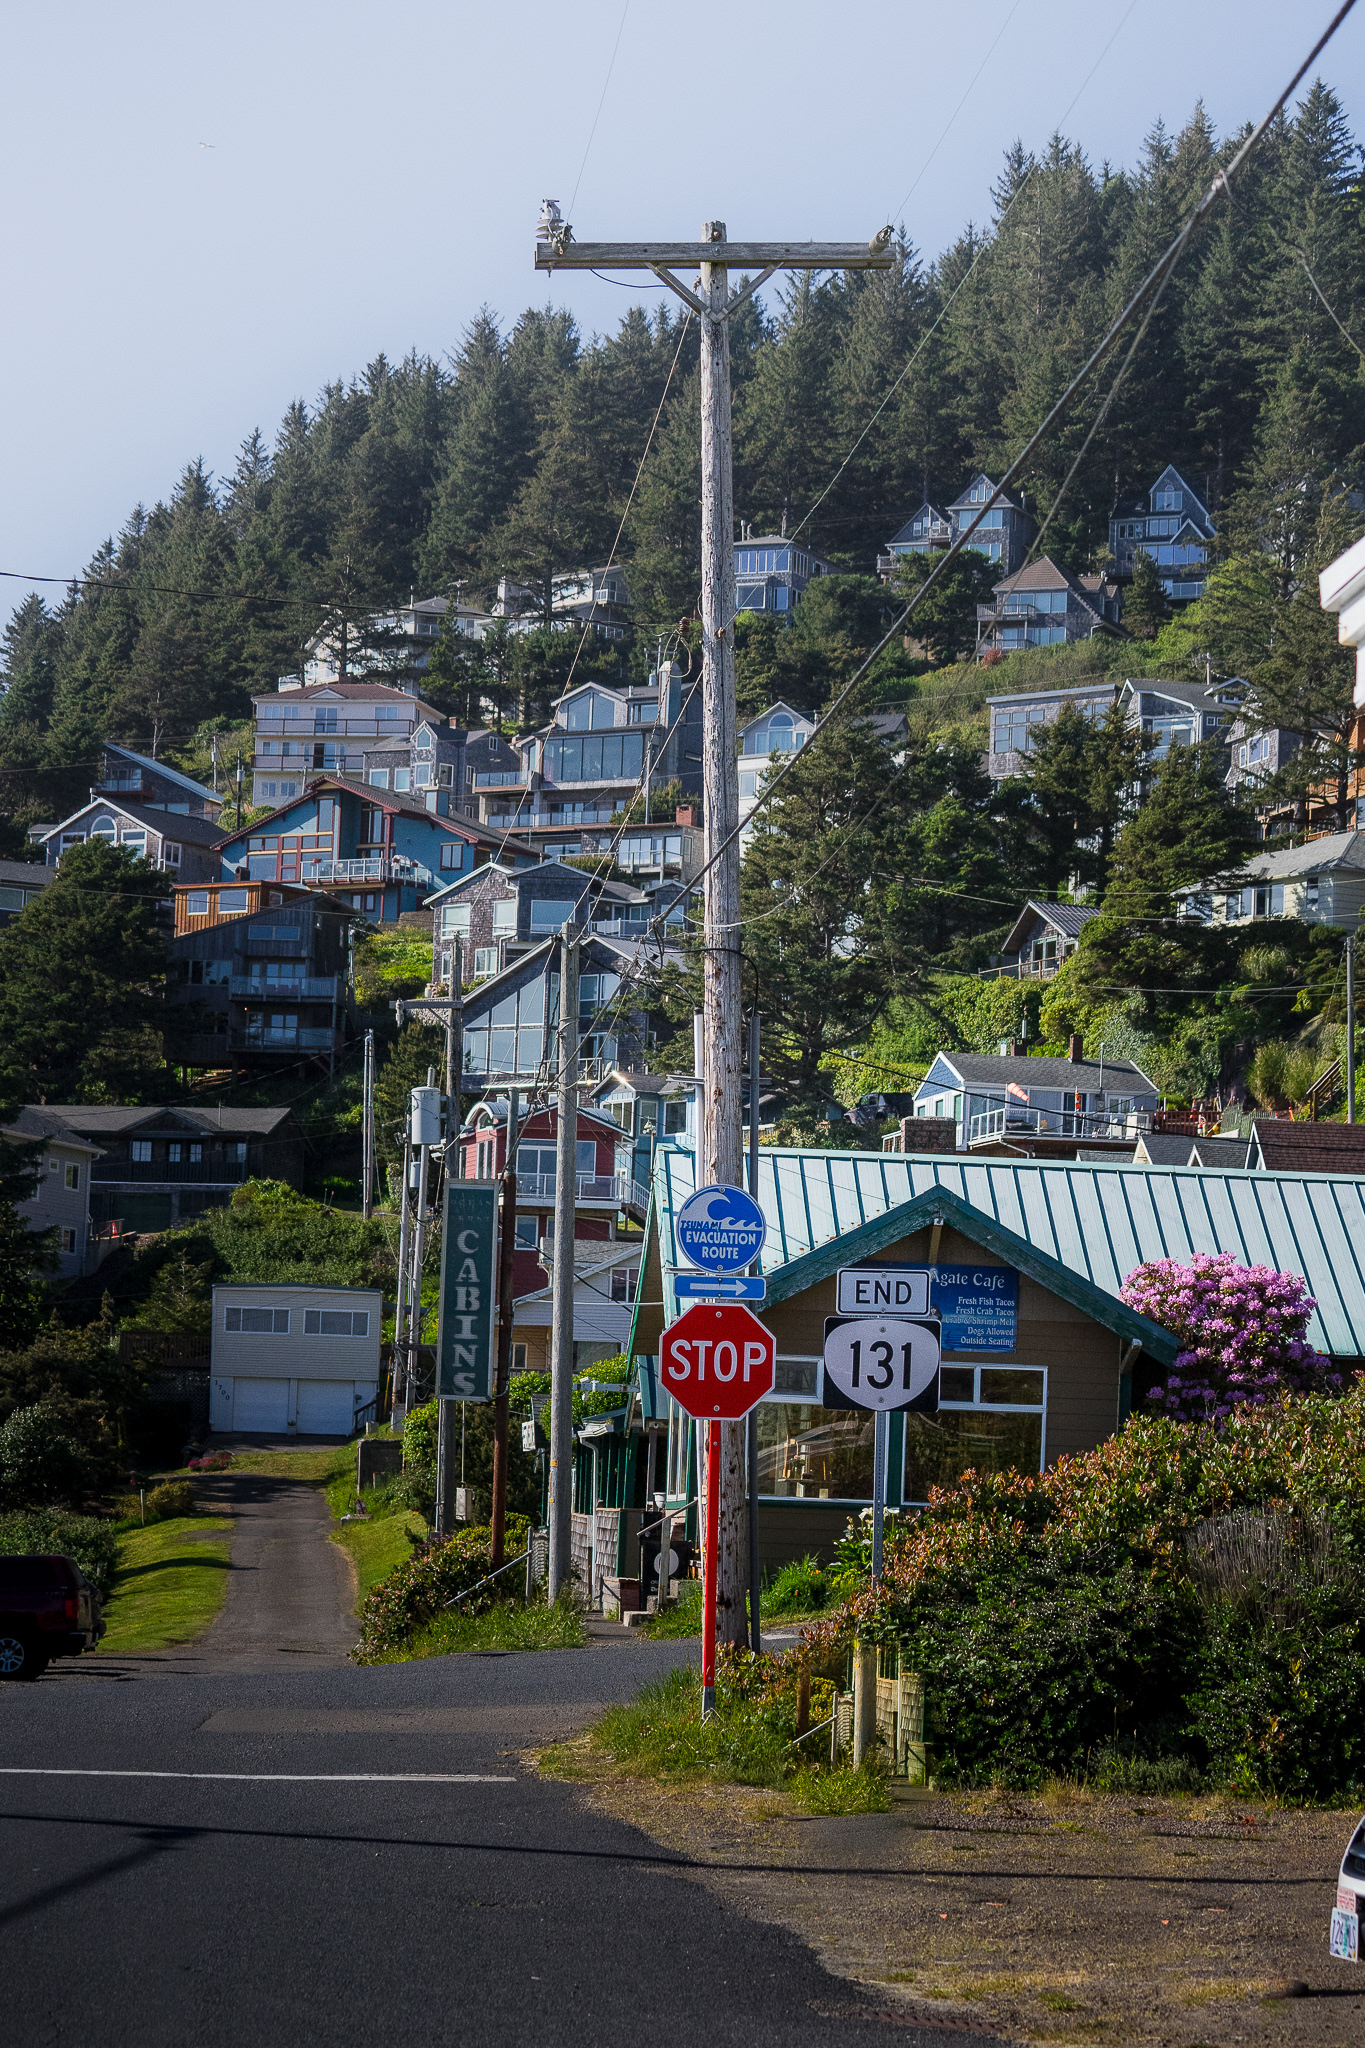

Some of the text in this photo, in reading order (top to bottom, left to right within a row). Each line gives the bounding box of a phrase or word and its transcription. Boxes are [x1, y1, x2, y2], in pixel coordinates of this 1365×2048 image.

[680, 1220, 722, 1230] TSUNAMI
[686, 1231, 756, 1245] EVACUATION
[702, 1246, 739, 1259] ROUTE
[930, 1269, 1004, 1290] Agate Café
[855, 1280, 912, 1305] END
[958, 1296, 1015, 1307] Fresh Fish Tacos
[452, 1229, 481, 1396] CABINS
[956, 1306, 1015, 1316] Fresh Crab Tacos
[945, 1316, 961, 1324] Crab
[972, 1317, 997, 1326] Shrimp
[1000, 1318, 1014, 1326] Melt
[967, 1327, 1014, 1336] Dogs Allowed
[960, 1336, 1014, 1347] Outside Seating
[668, 1339, 767, 1382] STOP
[850, 1340, 912, 1390] 131
[215, 1380, 230, 1400] 1700
